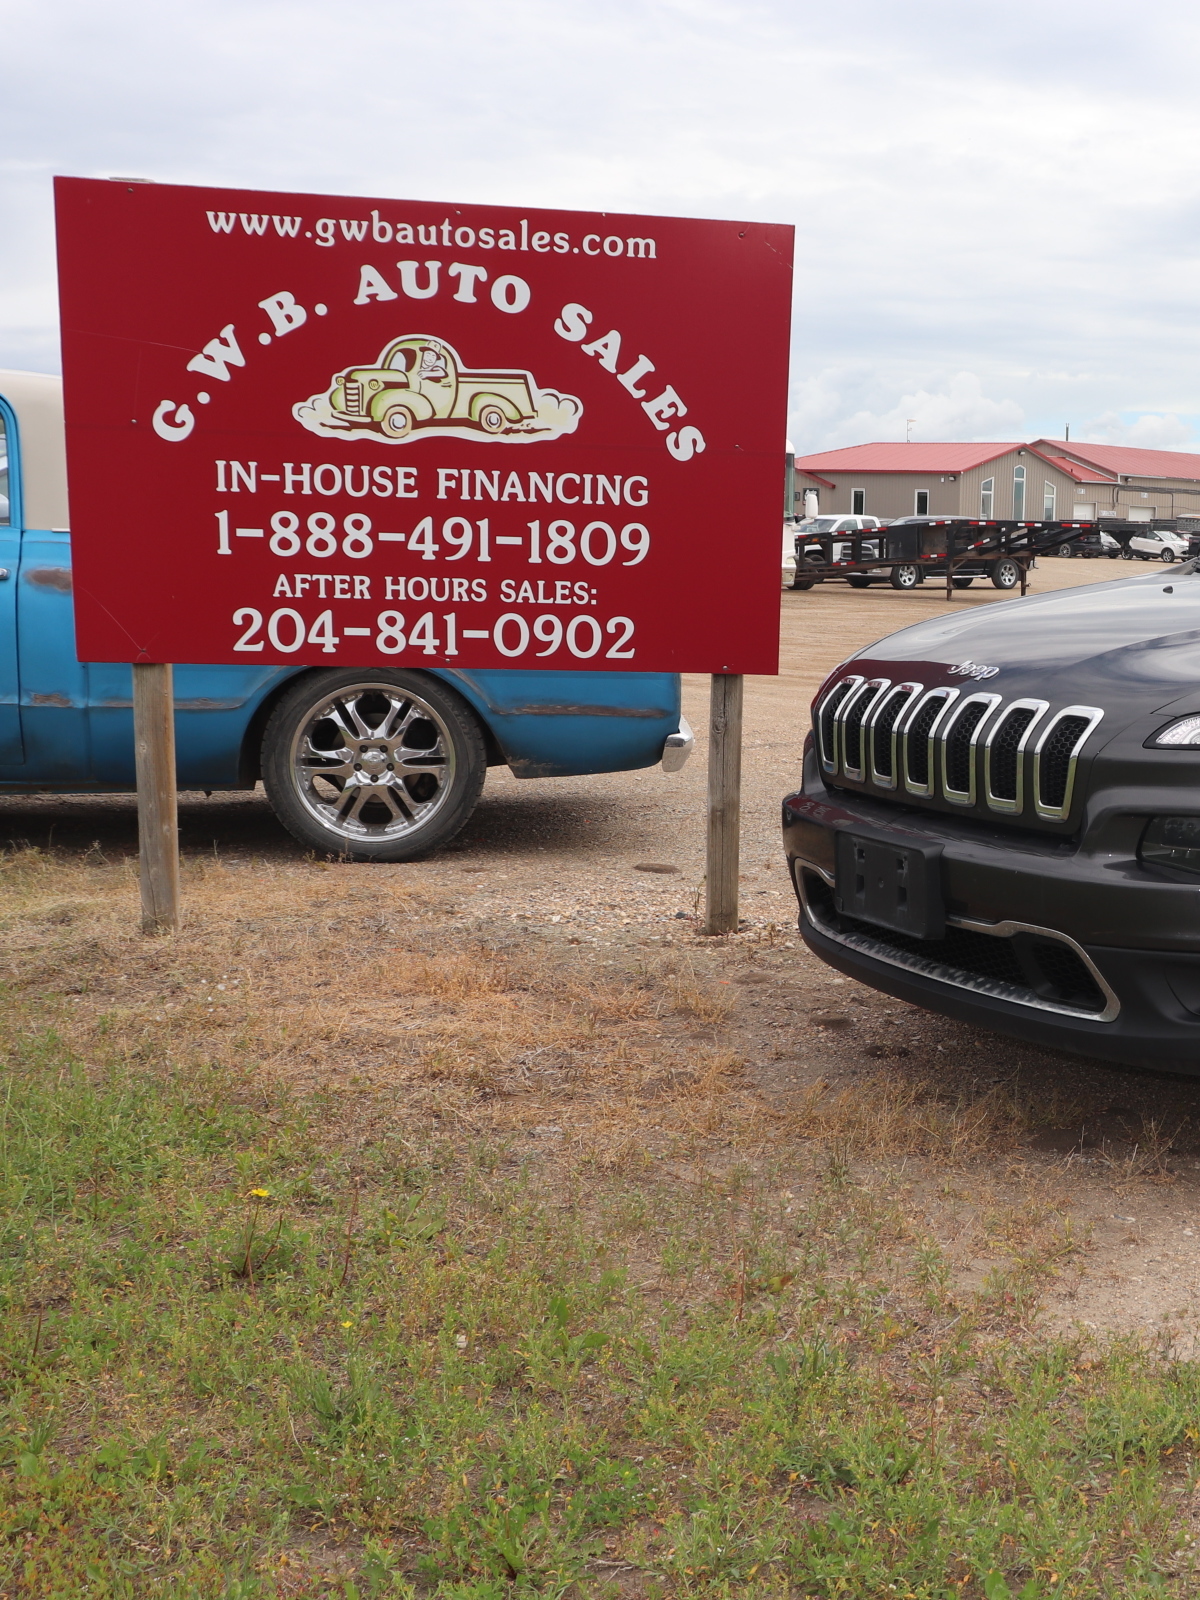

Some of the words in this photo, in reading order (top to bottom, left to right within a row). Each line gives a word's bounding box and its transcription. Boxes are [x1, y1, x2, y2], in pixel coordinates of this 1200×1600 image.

[206, 209, 658, 258] www.gwbautosales.com
[152, 290, 328, 442] G.W.B.
[354, 260, 531, 314] AUTO
[554, 302, 707, 462] SALES
[215, 459, 418, 498] IN-HOUSE
[436, 468, 650, 507] FINANCING
[215, 509, 650, 567] 1-888-491-1809
[272, 573, 371, 600] AFTER
[385, 577, 487, 603] HOURS
[500, 580, 599, 606] SALES:
[232, 607, 636, 659] 204-841-0902
[946, 659, 1000, 681] Jeep
